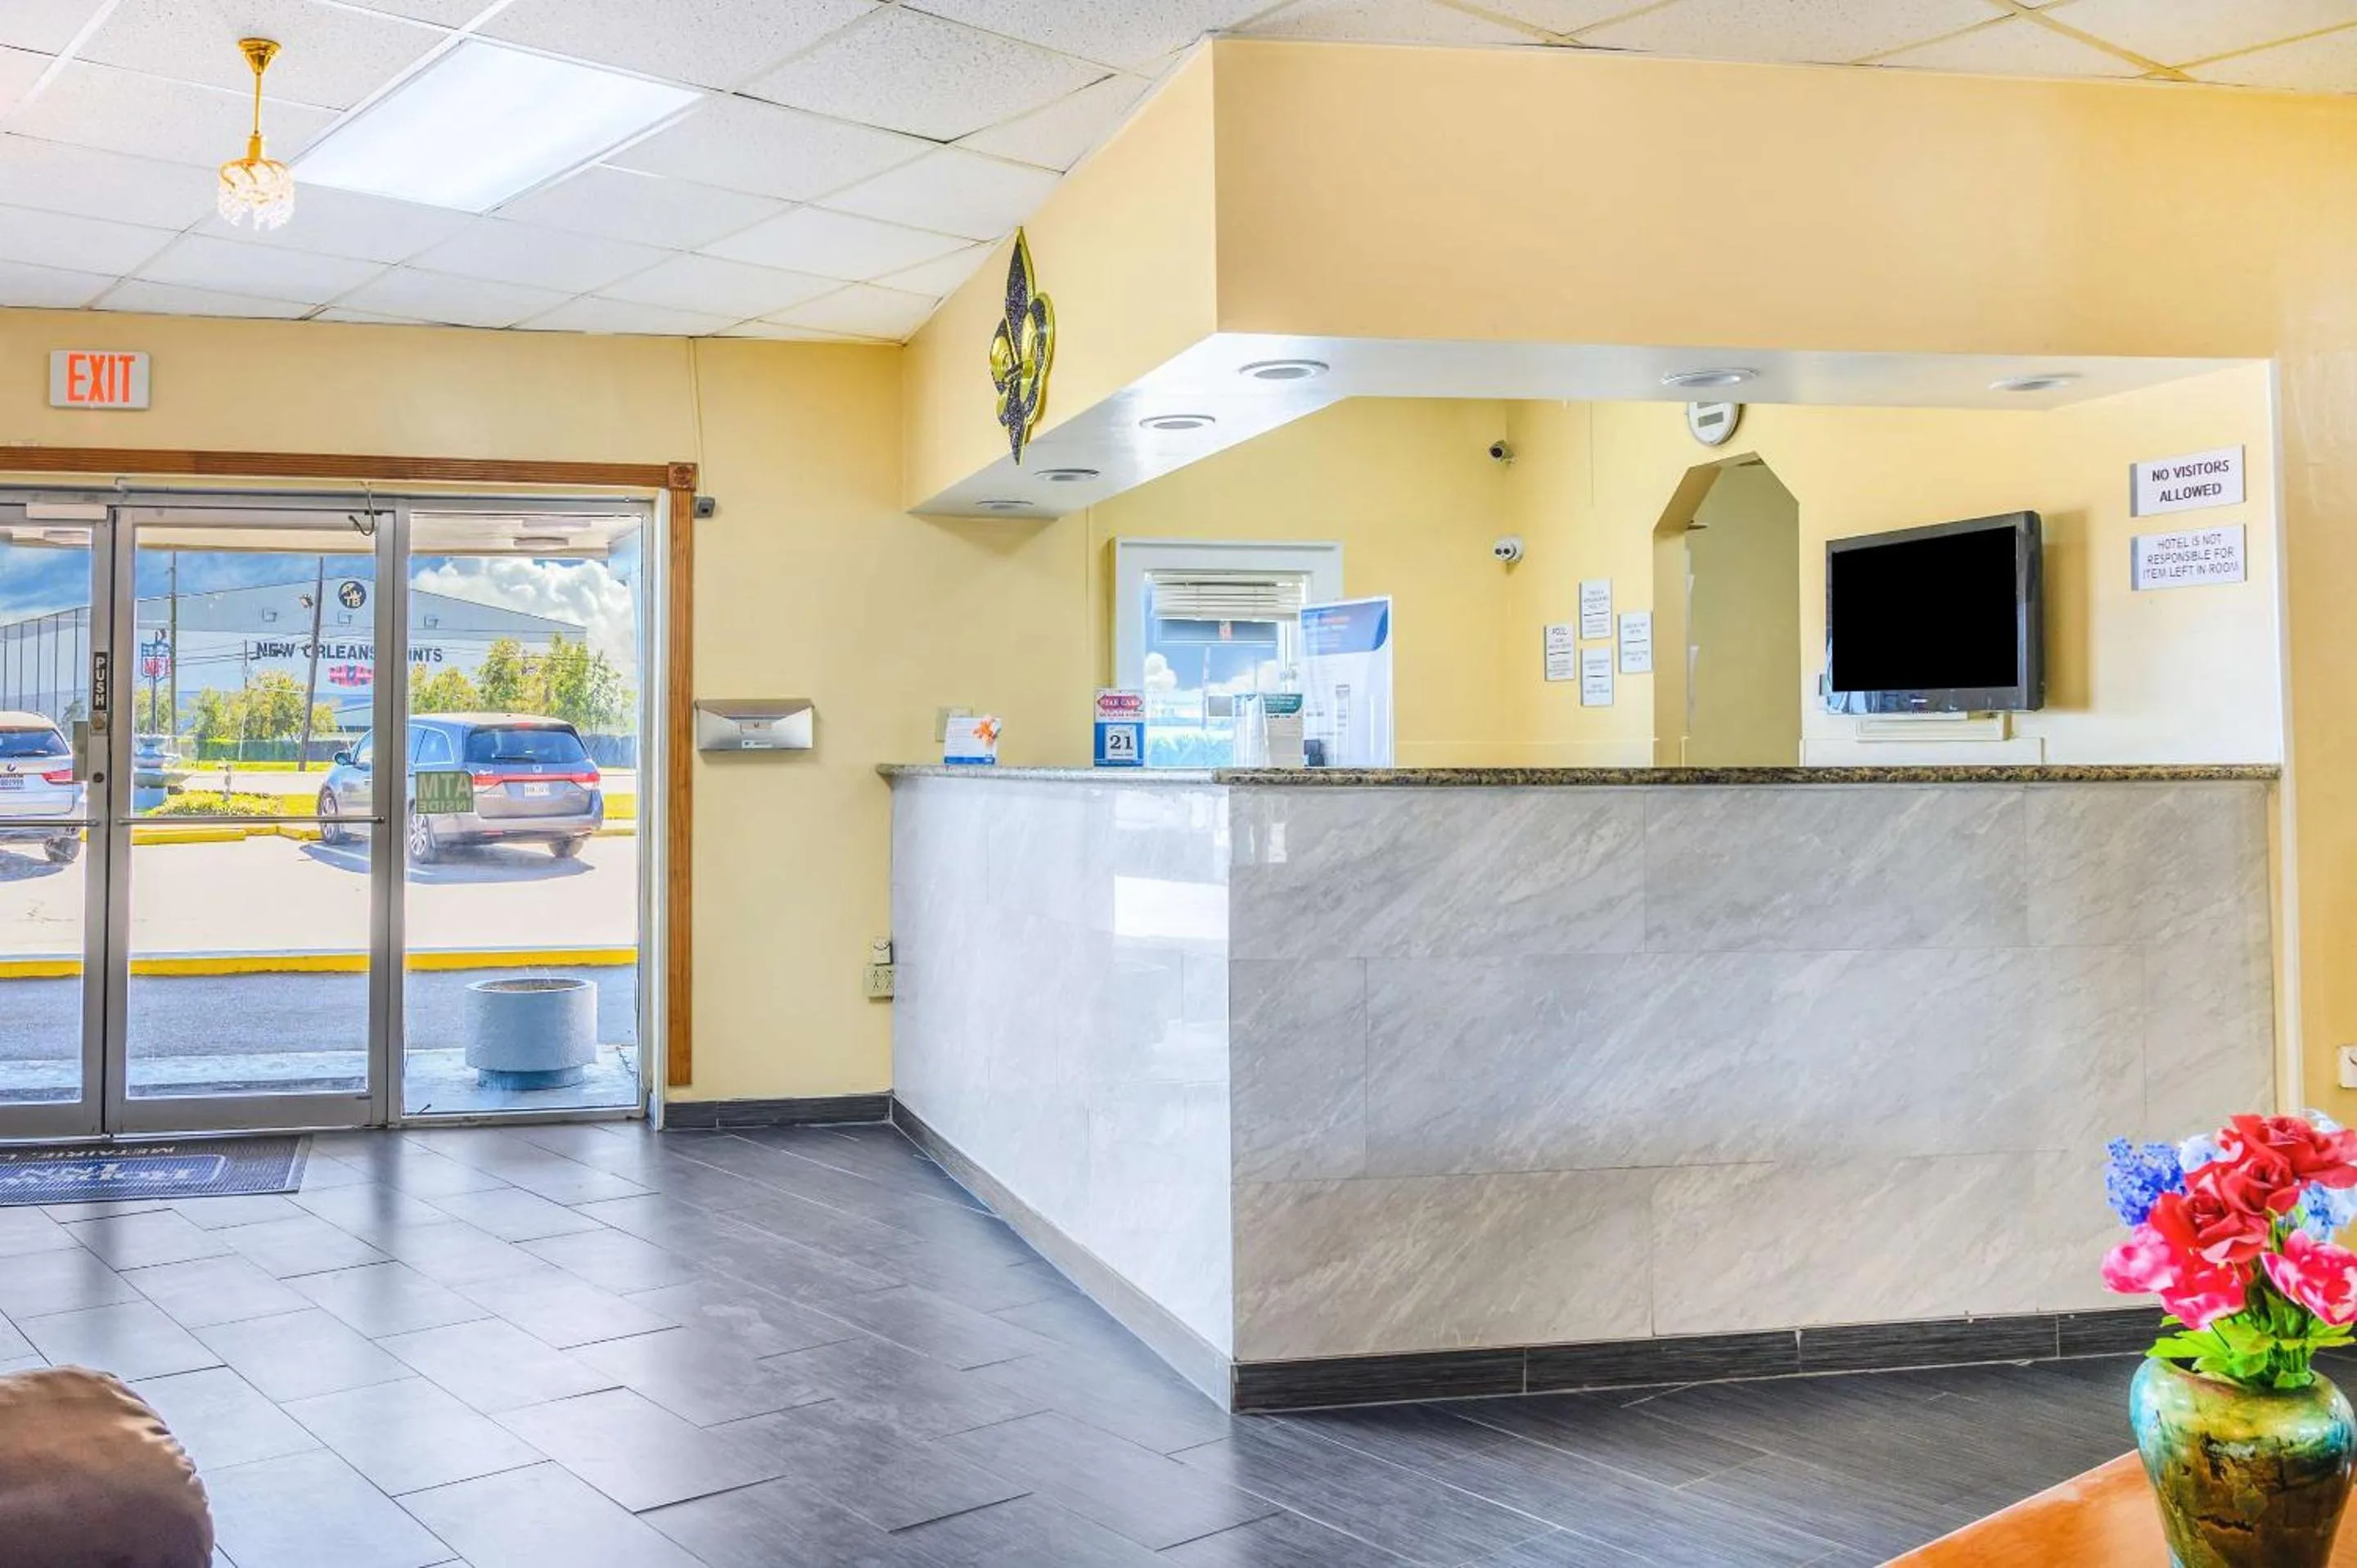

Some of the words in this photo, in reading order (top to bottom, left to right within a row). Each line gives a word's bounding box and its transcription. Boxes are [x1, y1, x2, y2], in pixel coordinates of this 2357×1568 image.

[66, 354, 135, 402] EXIT
[2152, 469, 2169, 481] NO
[2173, 460, 2229, 478] VISITORS
[2160, 483, 2221, 502] ALLOWED
[2157, 537, 2189, 549] HOTEL
[2193, 536, 2200, 546] IS
[2202, 534, 2221, 545] NOT
[2147, 549, 2211, 565] RESPONSIBLE
[2215, 547, 2234, 558] FOR
[2143, 568, 2165, 579] ITEM
[2170, 565, 2193, 577] LEFT
[2197, 564, 2205, 574] IN
[2209, 561, 2238, 573] ROOM
[256, 642, 295, 657] NEW
[95, 656, 106, 706] PUSH
[1110, 735, 1133, 750] 21
